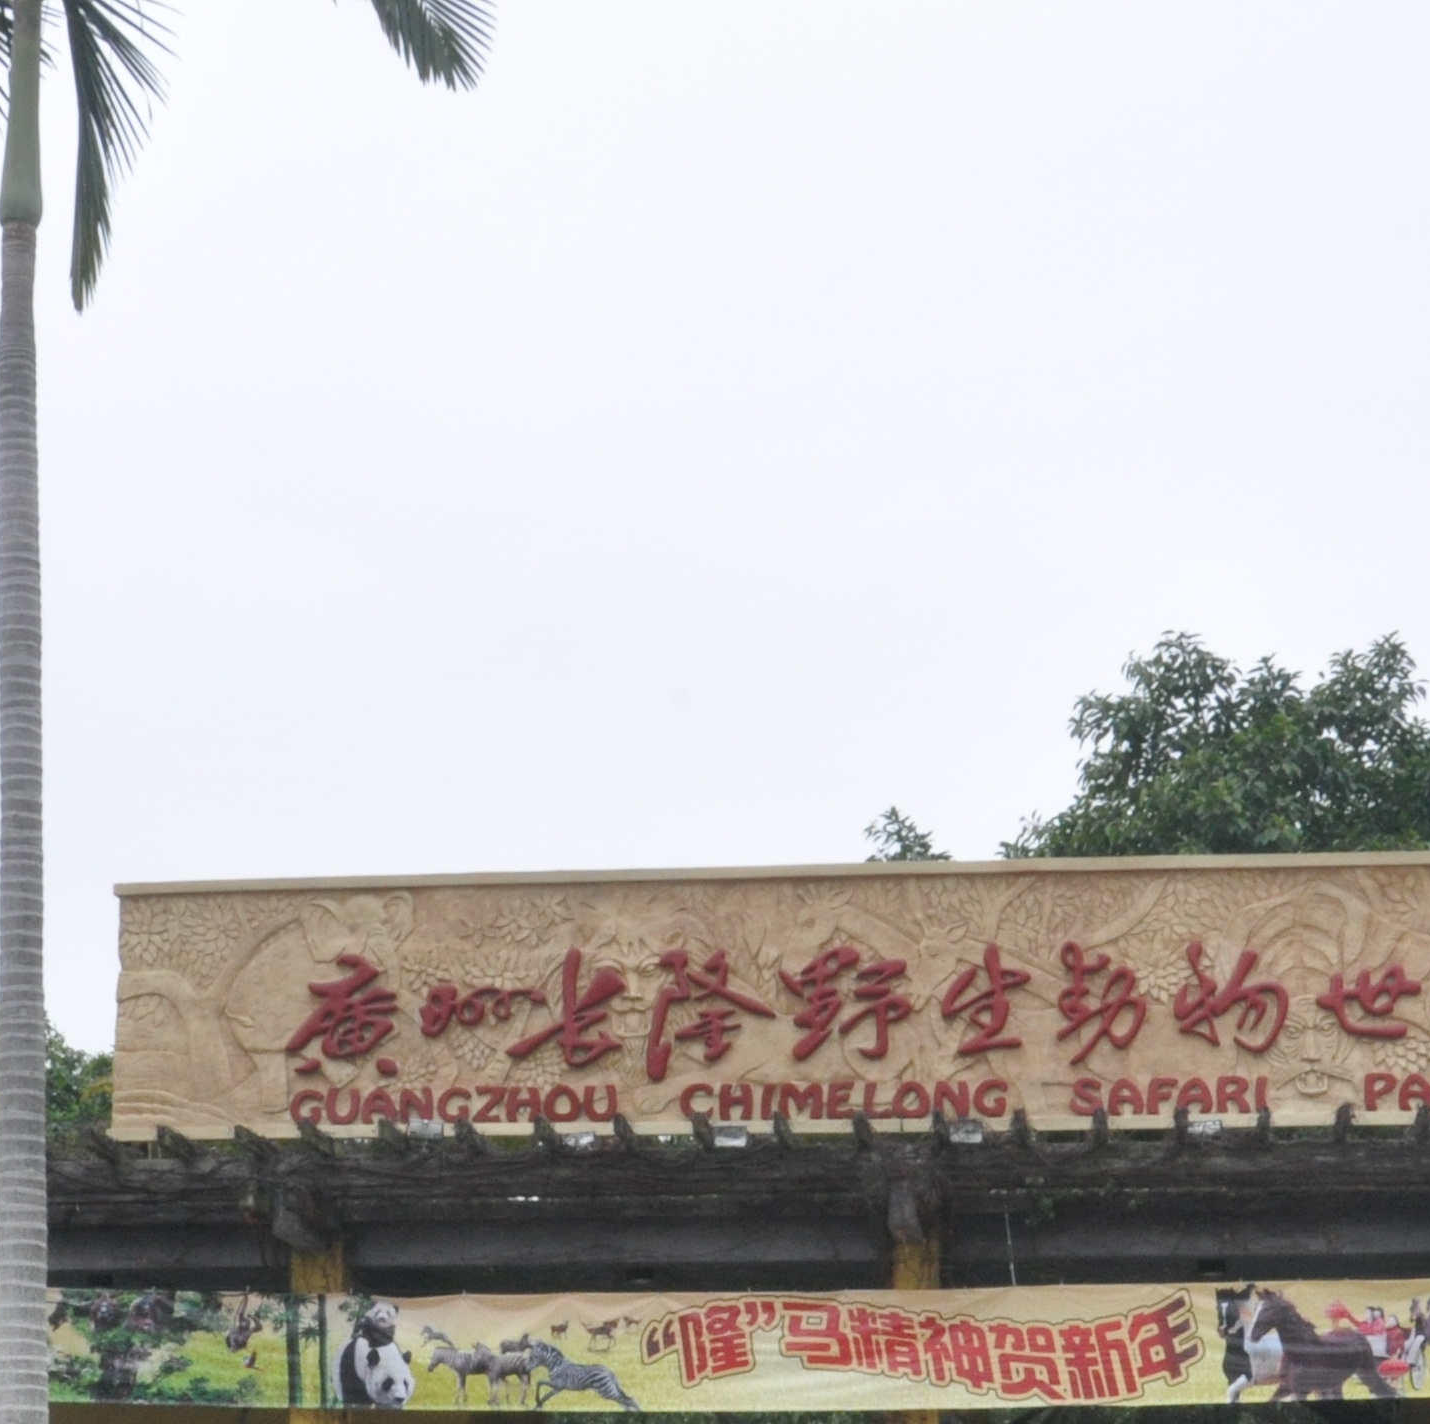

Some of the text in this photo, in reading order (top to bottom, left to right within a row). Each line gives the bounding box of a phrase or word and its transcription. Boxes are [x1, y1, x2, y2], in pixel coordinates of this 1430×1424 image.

[289, 1083, 618, 1124] GUANGZHOU
[680, 1079, 1008, 1121] CHIMELONG
[1069, 1075, 1268, 1116] SAFARI
